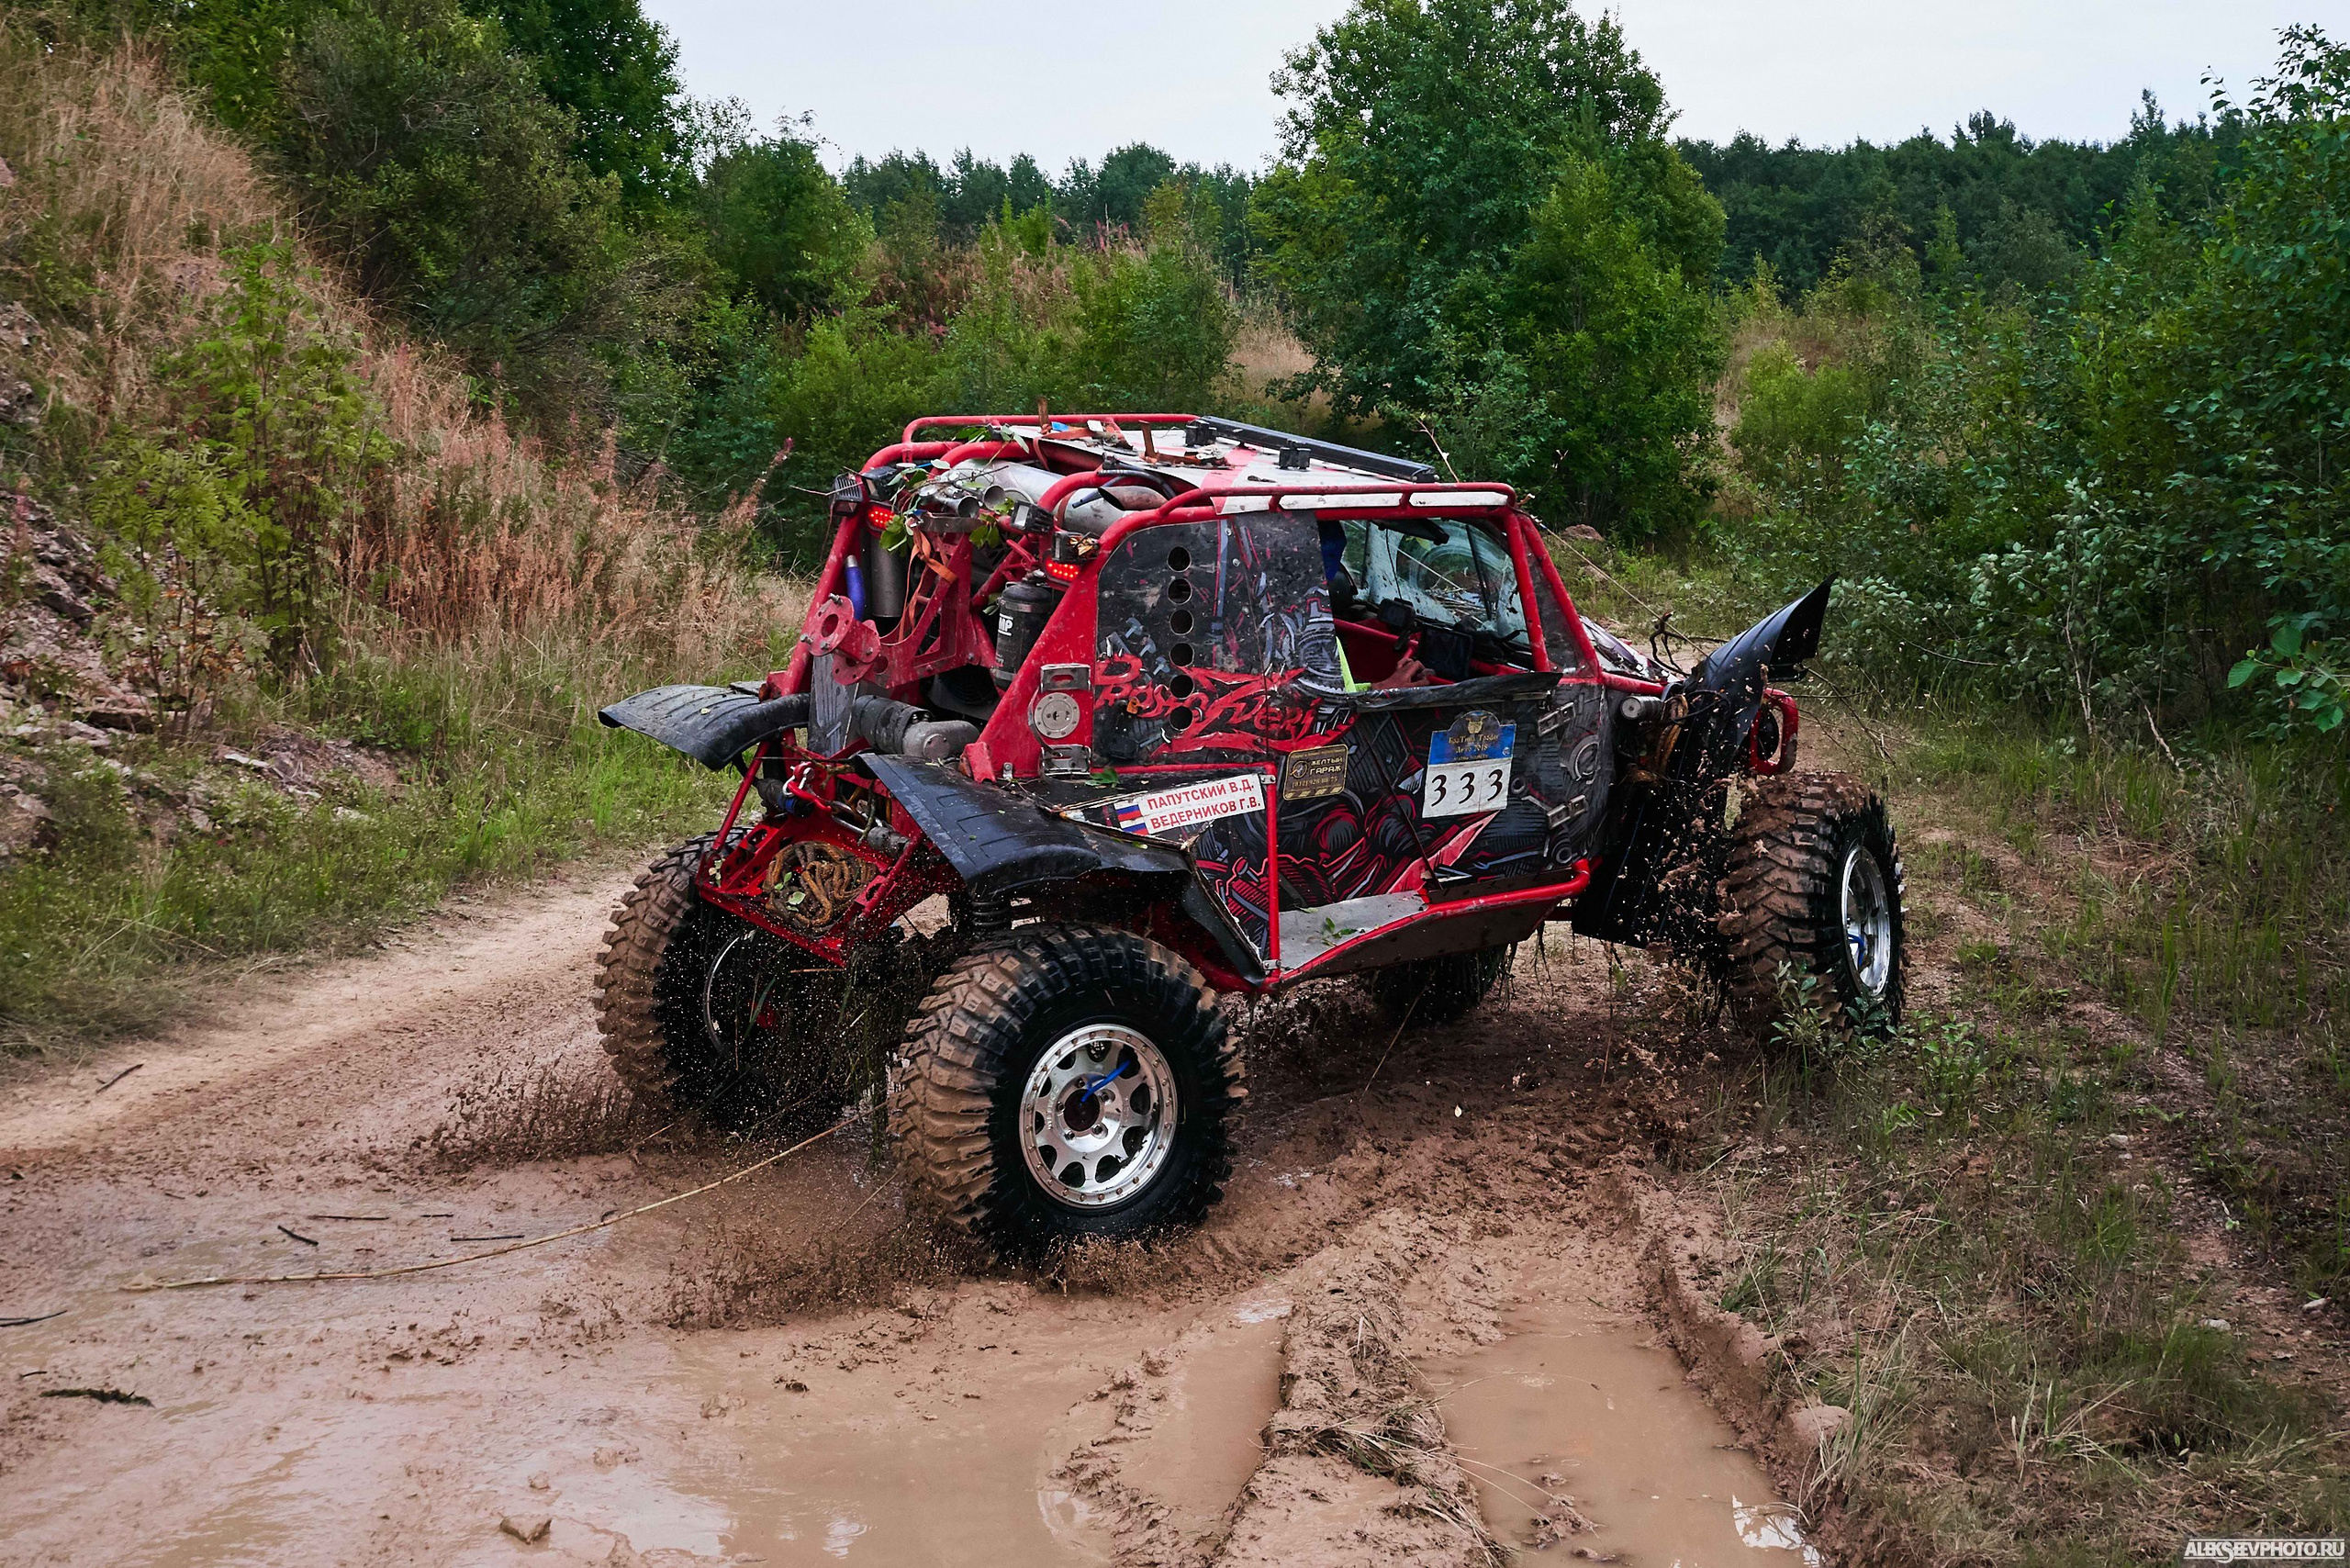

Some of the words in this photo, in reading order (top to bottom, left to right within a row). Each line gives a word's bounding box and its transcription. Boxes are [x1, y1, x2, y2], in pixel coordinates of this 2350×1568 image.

[1309, 766, 1341, 775] ГАРАЖ
[1147, 782, 1226, 810] ПАПУТСКИЙ
[1228, 778, 1254, 793] В.Д.
[1150, 801, 1237, 829] ВЕДЕРНИКОВ
[1239, 796, 1260, 811] Г.В.
